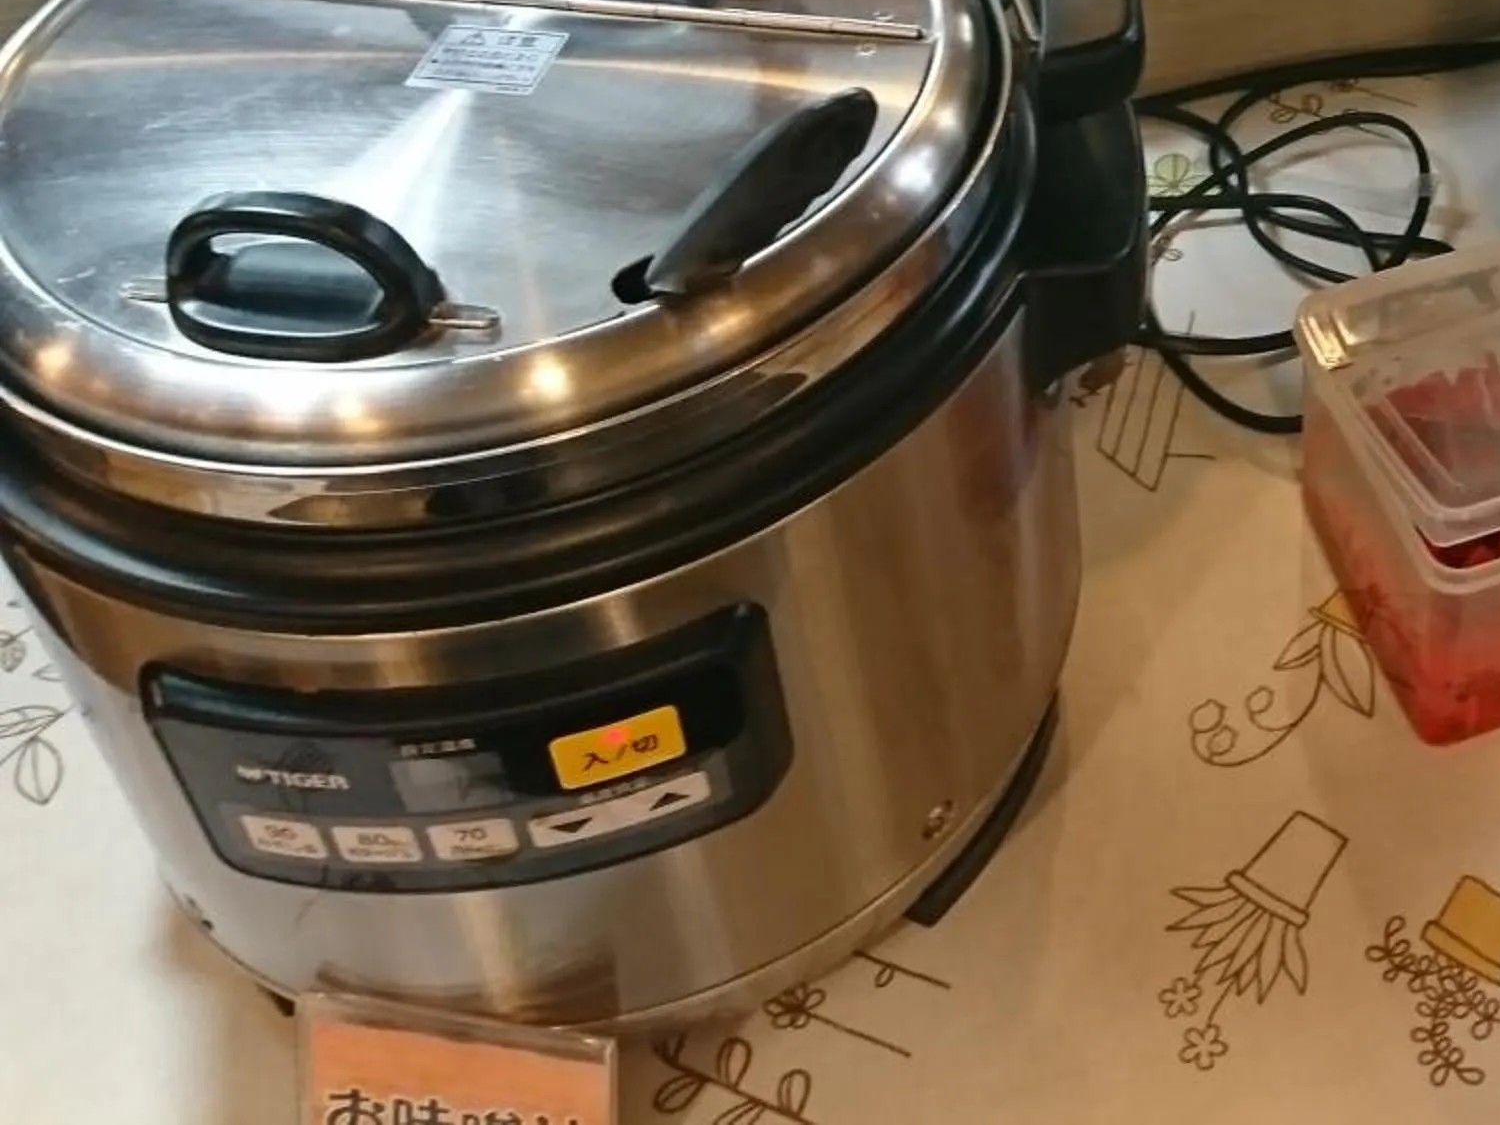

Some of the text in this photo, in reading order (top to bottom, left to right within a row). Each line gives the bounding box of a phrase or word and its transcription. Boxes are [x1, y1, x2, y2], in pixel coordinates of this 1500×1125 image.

[581, 733, 659, 773] 入/切
[264, 768, 350, 791] TIGER
[453, 827, 488, 842] 70
